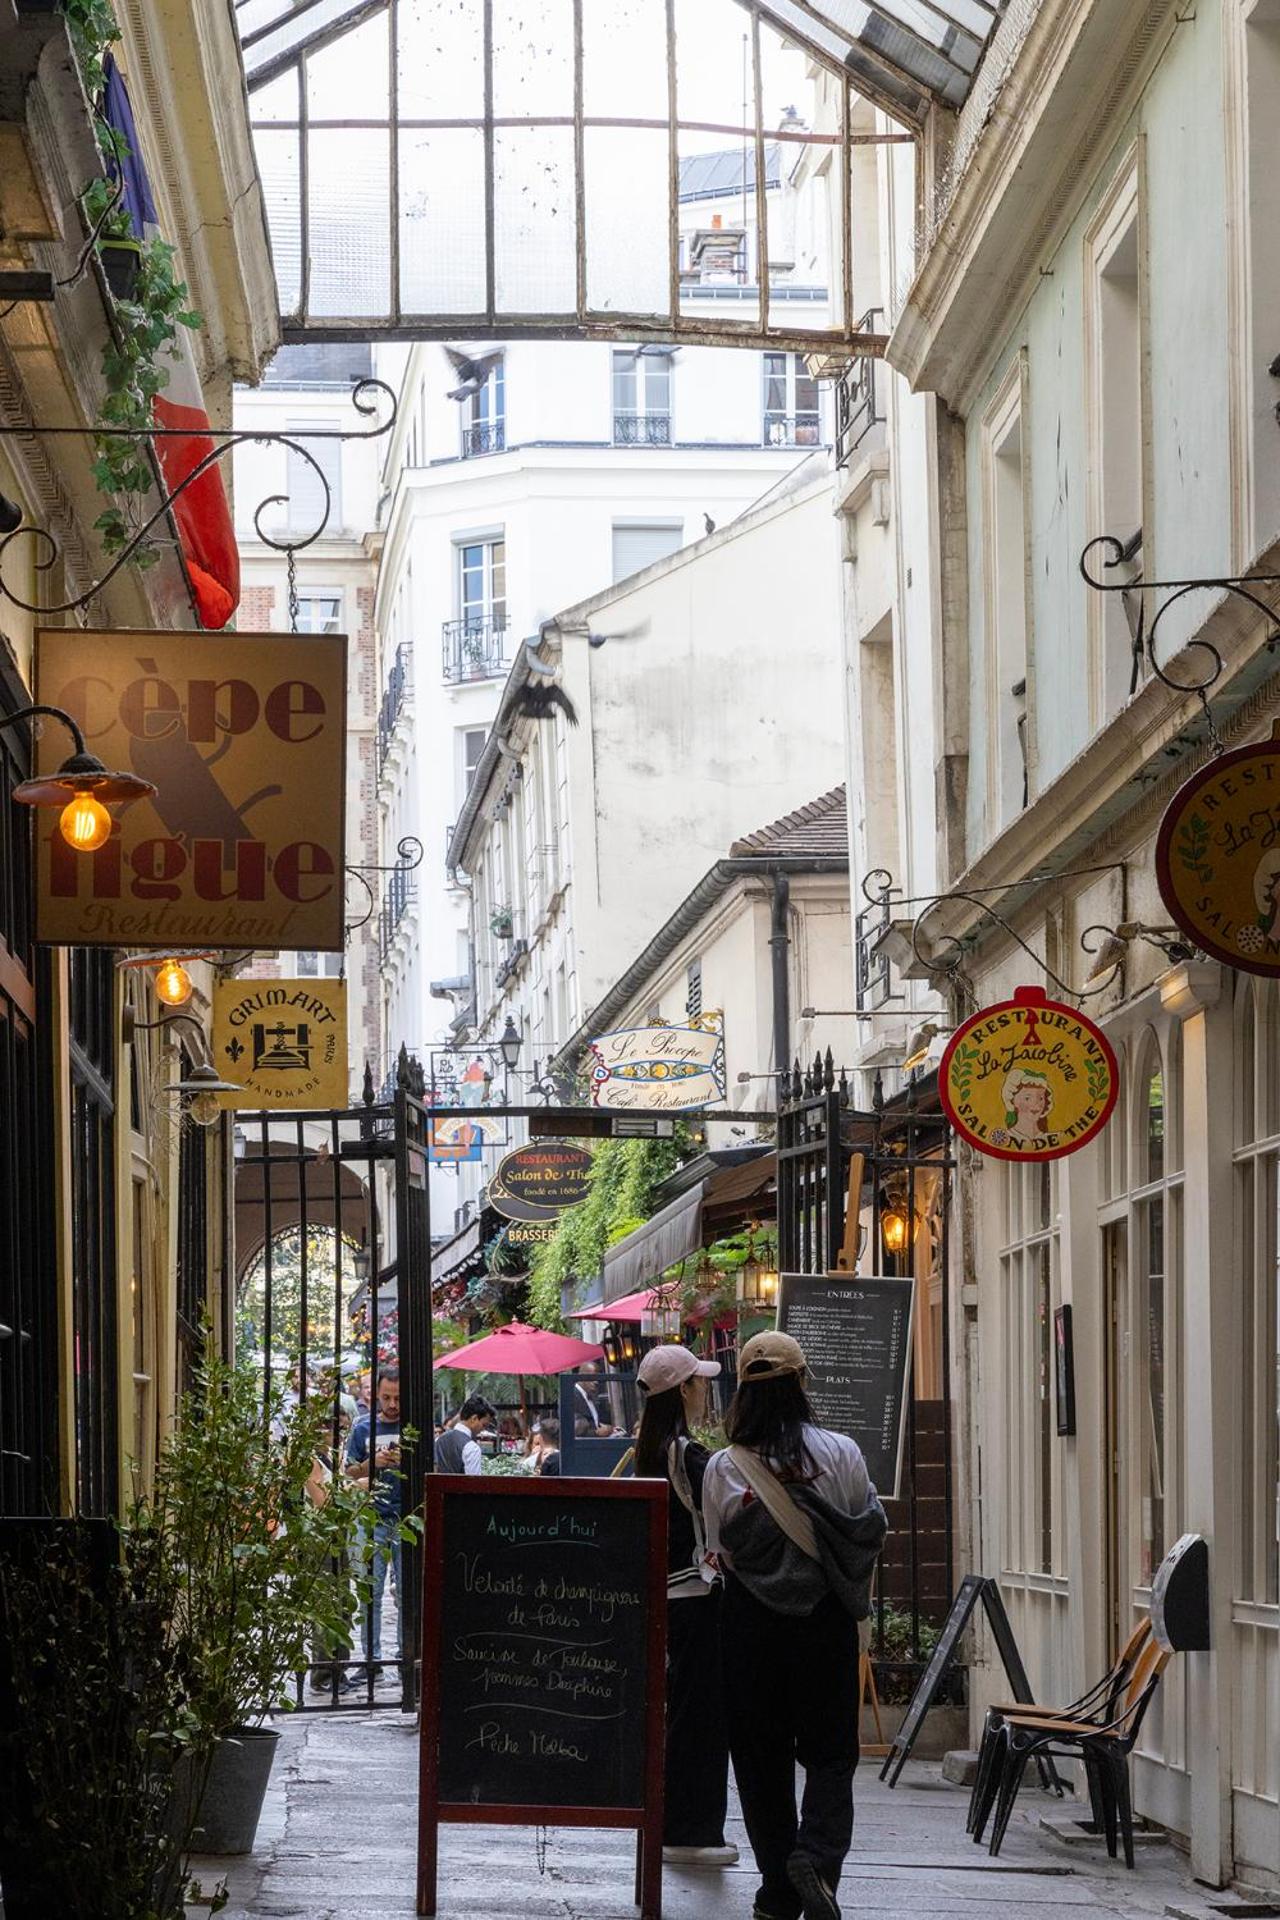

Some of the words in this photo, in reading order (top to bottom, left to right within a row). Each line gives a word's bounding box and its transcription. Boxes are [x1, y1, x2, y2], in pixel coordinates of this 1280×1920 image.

[57, 657, 326, 743] cèpe
[77, 902, 299, 939] Restaurant
[229, 988, 337, 1027] GRIMART
[608, 1032, 638, 1062] Le
[645, 1030, 704, 1062] Procope
[976, 1050, 1001, 1080] La
[1000, 1042, 1078, 1083] Jacobine
[244, 1076, 321, 1099] HANDMADE
[607, 1087, 638, 1110] Café
[645, 1088, 712, 1109] Restaurant
[1032, 1133, 1060, 1151] DE
[1064, 1105, 1100, 1138] THE
[515, 1154, 586, 1165] RESTAURANT
[505, 1168, 542, 1184] Salon
[544, 1168, 564, 1181] de
[524, 1187, 546, 1197] fondé
[548, 1188, 558, 1196] en
[826, 1376, 851, 1384] PLATS
[486, 1515, 598, 1542] Aujourd'hui
[455, 1552, 525, 1597] Velouté
[507, 1603, 525, 1626] de
[529, 1603, 581, 1628] Paris
[532, 1649, 549, 1667] de
[471, 1667, 540, 1692] pommes
[529, 1730, 588, 1762] Melba
